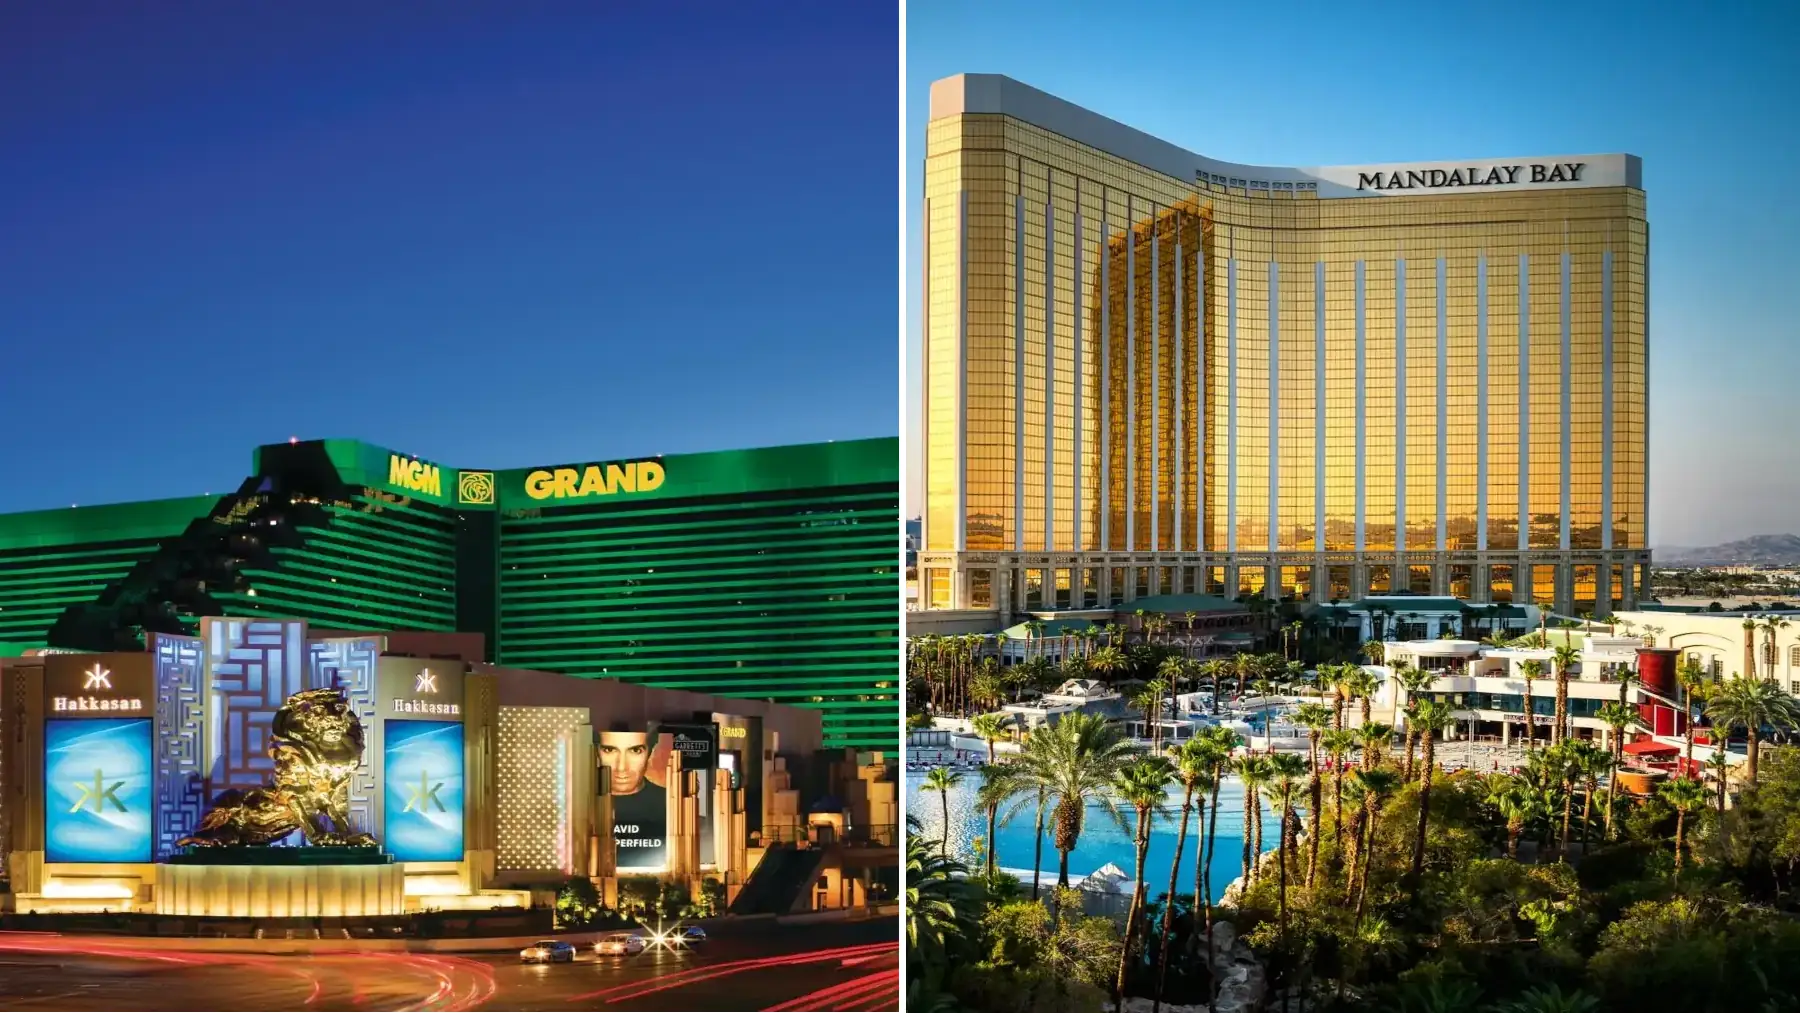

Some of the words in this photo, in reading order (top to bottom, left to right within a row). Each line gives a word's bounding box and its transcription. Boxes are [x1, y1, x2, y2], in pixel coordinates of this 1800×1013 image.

[1357, 165, 1520, 191] MANDALAY
[1529, 163, 1584, 183] BAY
[389, 454, 442, 497] MGM
[524, 461, 665, 500] GRAND
[53, 696, 142, 711] Hakkasan
[393, 699, 460, 715] Hakkasan
[614, 824, 640, 834] AVID
